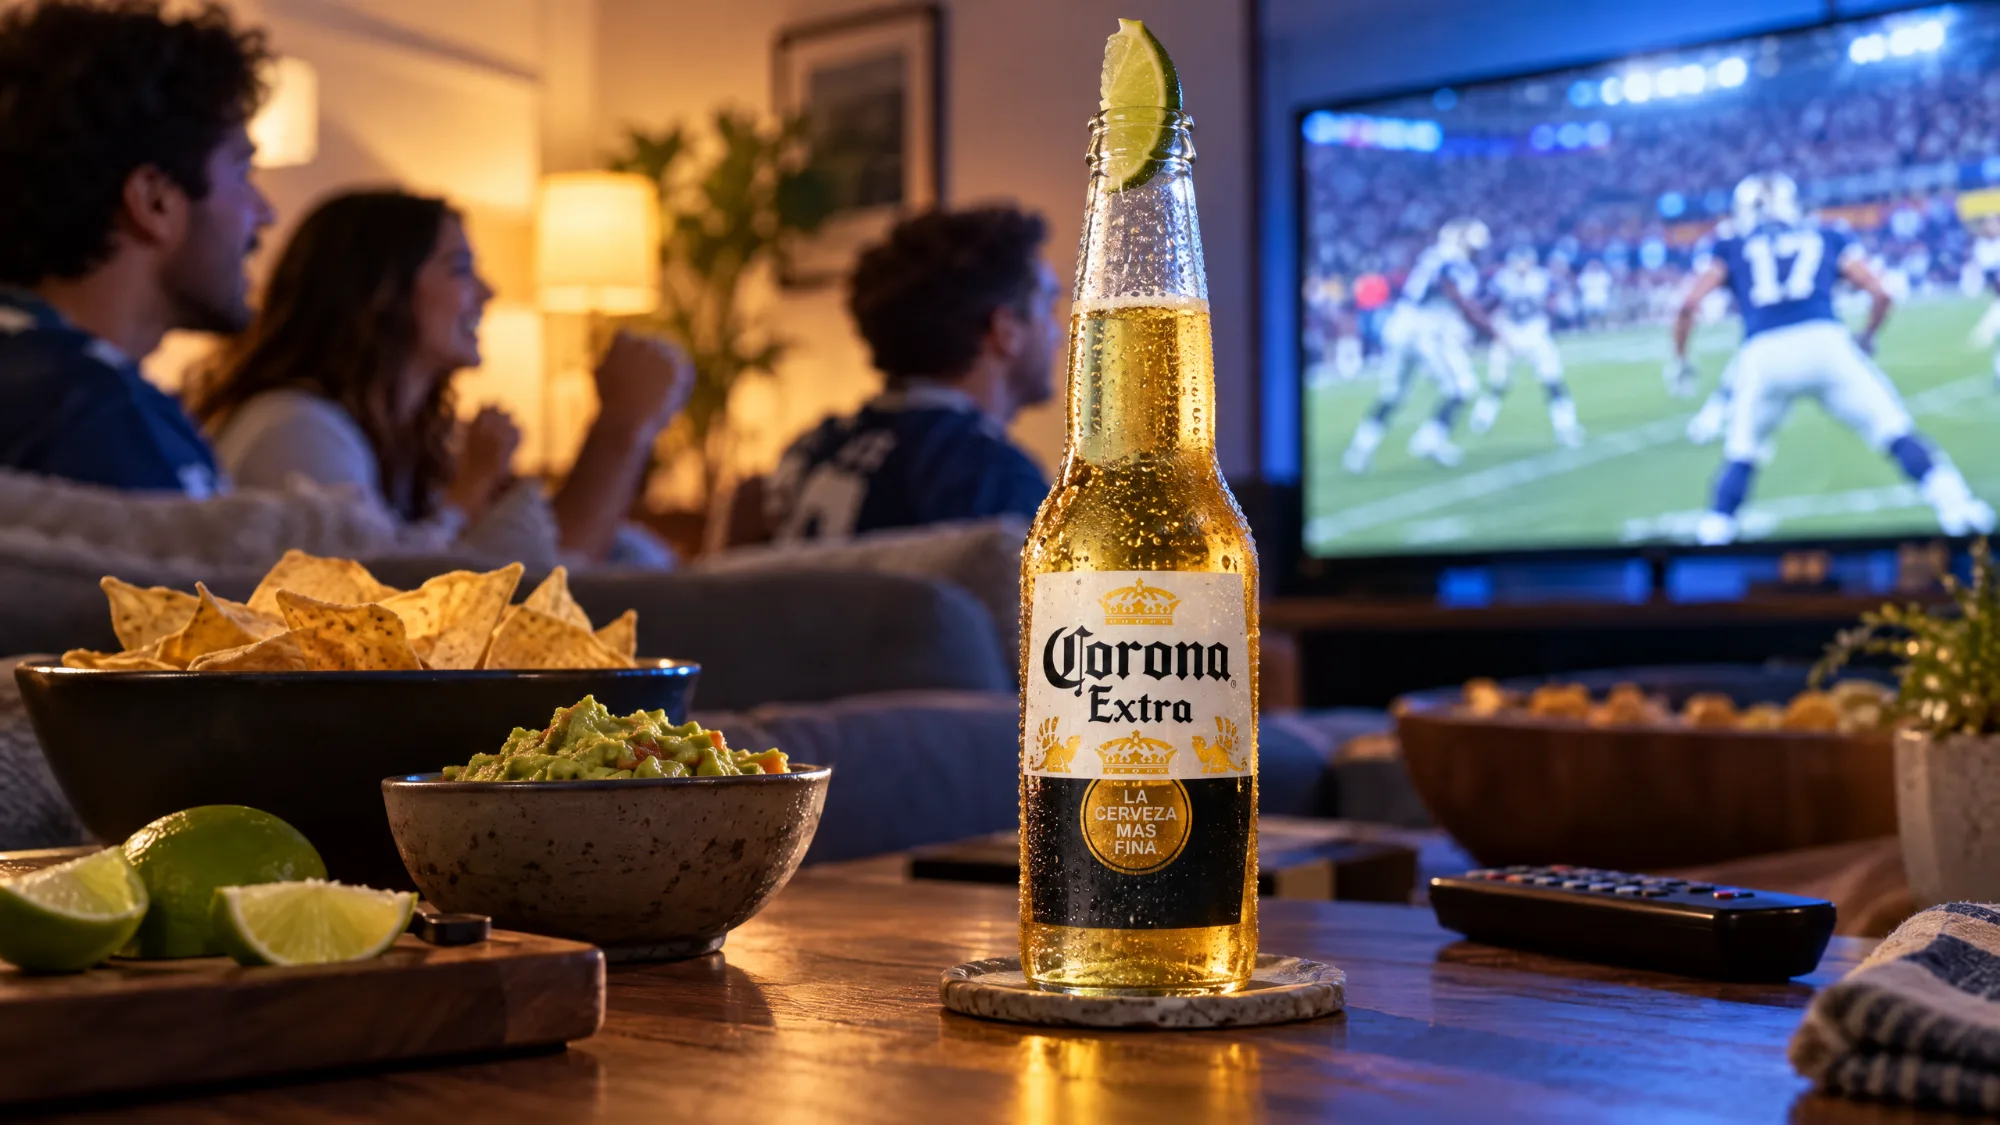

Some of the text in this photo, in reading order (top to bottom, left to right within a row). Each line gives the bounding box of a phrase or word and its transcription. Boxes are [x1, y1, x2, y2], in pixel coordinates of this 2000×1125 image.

[1742, 230, 1824, 307] 17
[1043, 625, 1231, 697] Corona
[1088, 684, 1193, 723] Extra
[1124, 789, 1148, 804] LA
[1095, 806, 1177, 821] CERVEZA
[1116, 823, 1156, 838] MAS
[1114, 840, 1156, 855] FINA
